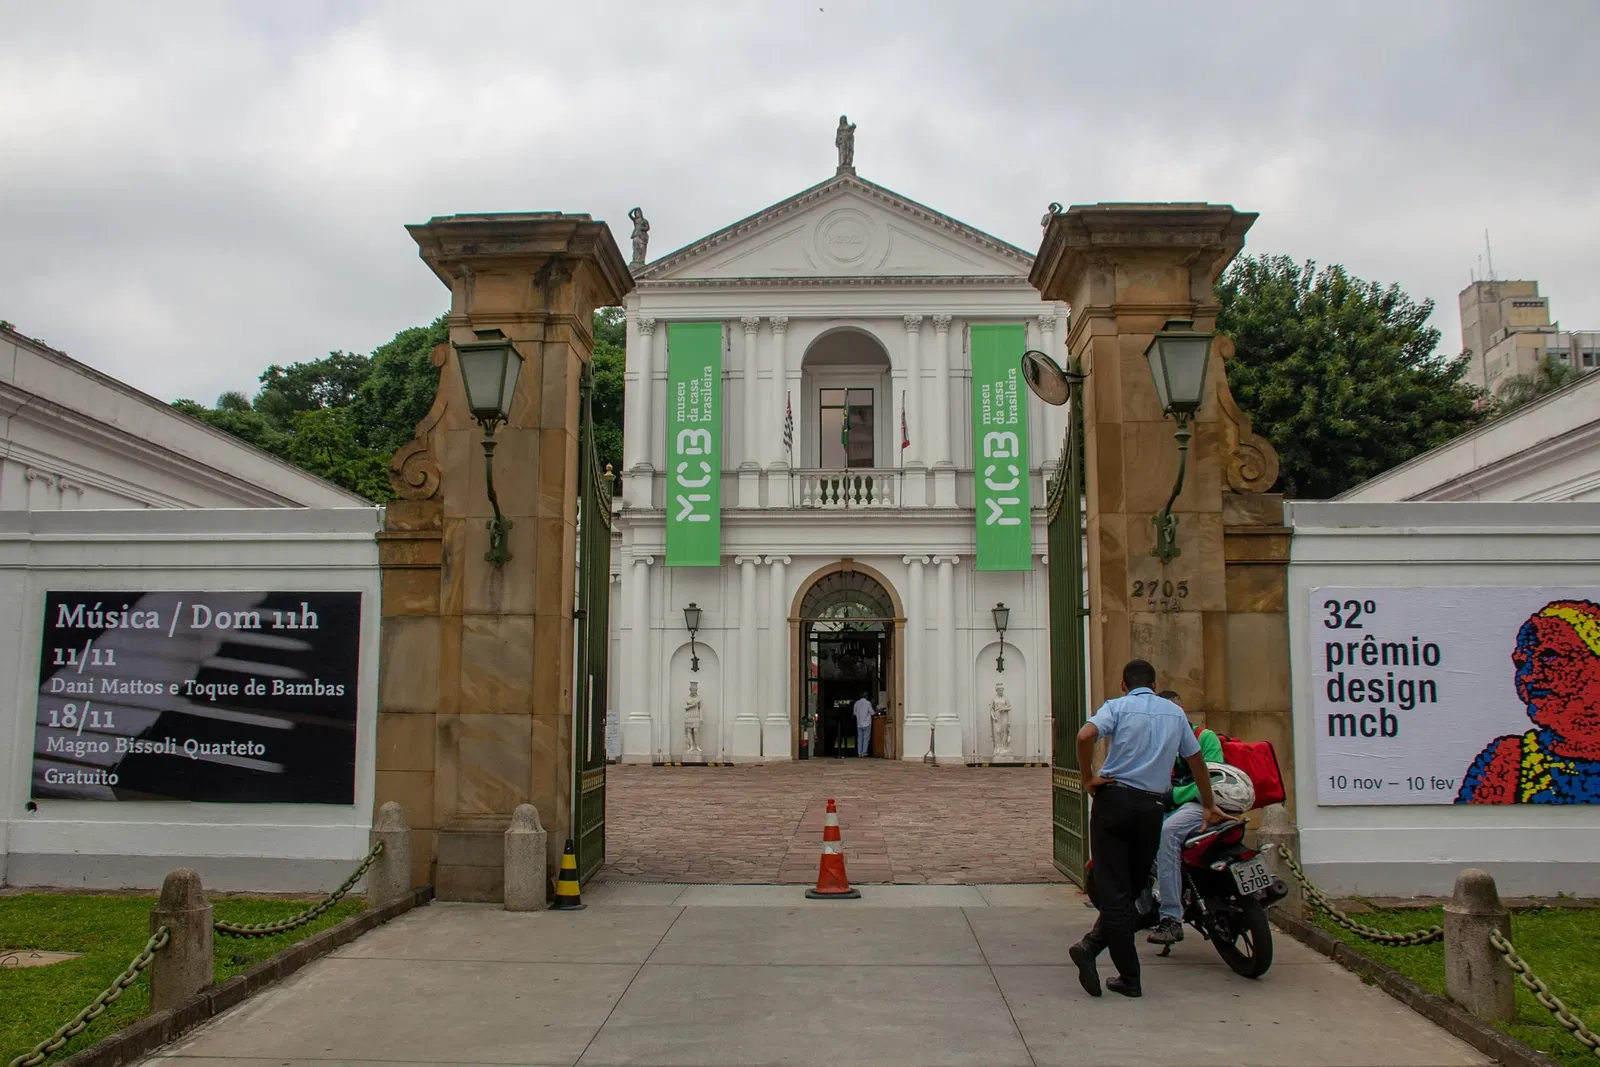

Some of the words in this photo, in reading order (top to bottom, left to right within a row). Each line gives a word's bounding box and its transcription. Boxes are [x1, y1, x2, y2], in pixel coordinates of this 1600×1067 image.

[677, 382, 686, 422] museu
[690, 379, 698, 404] casa
[700, 365, 712, 421] brasileira
[996, 381, 1004, 407] casa
[1006, 368, 1017, 424] brasileira
[687, 408, 698, 422] da
[993, 411, 1004, 425] da
[676, 428, 711, 522] MCB
[984, 431, 1020, 526] MCB
[1131, 579, 1188, 598] 2705
[55, 602, 160, 629] Música
[191, 604, 261, 629] Dom
[272, 602, 319, 629] 11h
[1323, 600, 1376, 629] 32º
[53, 638, 116, 673] 11/11
[1325, 634, 1441, 672] prêmio
[50, 678, 94, 694] Dani
[101, 679, 163, 694] Mattos
[169, 683, 179, 695] e
[184, 680, 238, 700] Toque
[244, 680, 266, 695] de
[271, 680, 345, 696] Bambas
[1327, 672, 1437, 710] design
[49, 701, 115, 736] 18/11
[1328, 708, 1398, 737] mcb
[46, 737, 109, 757] Magno
[115, 737, 176, 754] Bissoli
[184, 739, 266, 759] Quarteto
[44, 768, 119, 785] Gratuito
[1328, 776, 1347, 789] 10
[1354, 778, 1382, 789] nov
[1407, 777, 1424, 790] 10
[1430, 776, 1454, 790] fev
[1241, 875, 1269, 892] 6708
